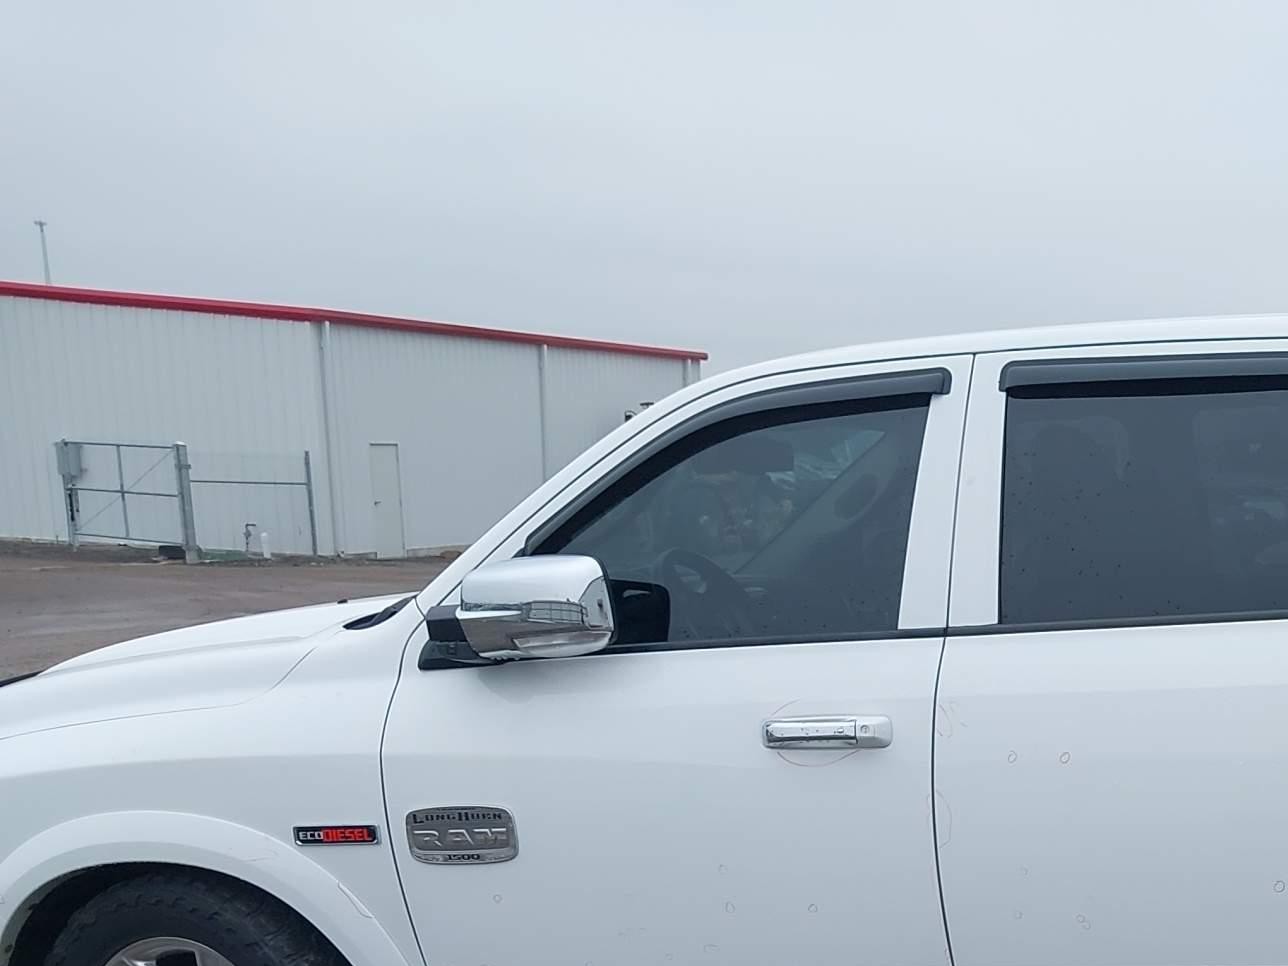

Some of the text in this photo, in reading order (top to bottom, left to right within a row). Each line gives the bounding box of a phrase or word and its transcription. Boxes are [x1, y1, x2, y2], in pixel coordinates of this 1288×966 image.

[298, 829, 372, 842] ECODIESEL
[413, 828, 507, 846] RAM
[447, 853, 481, 861] 1500
